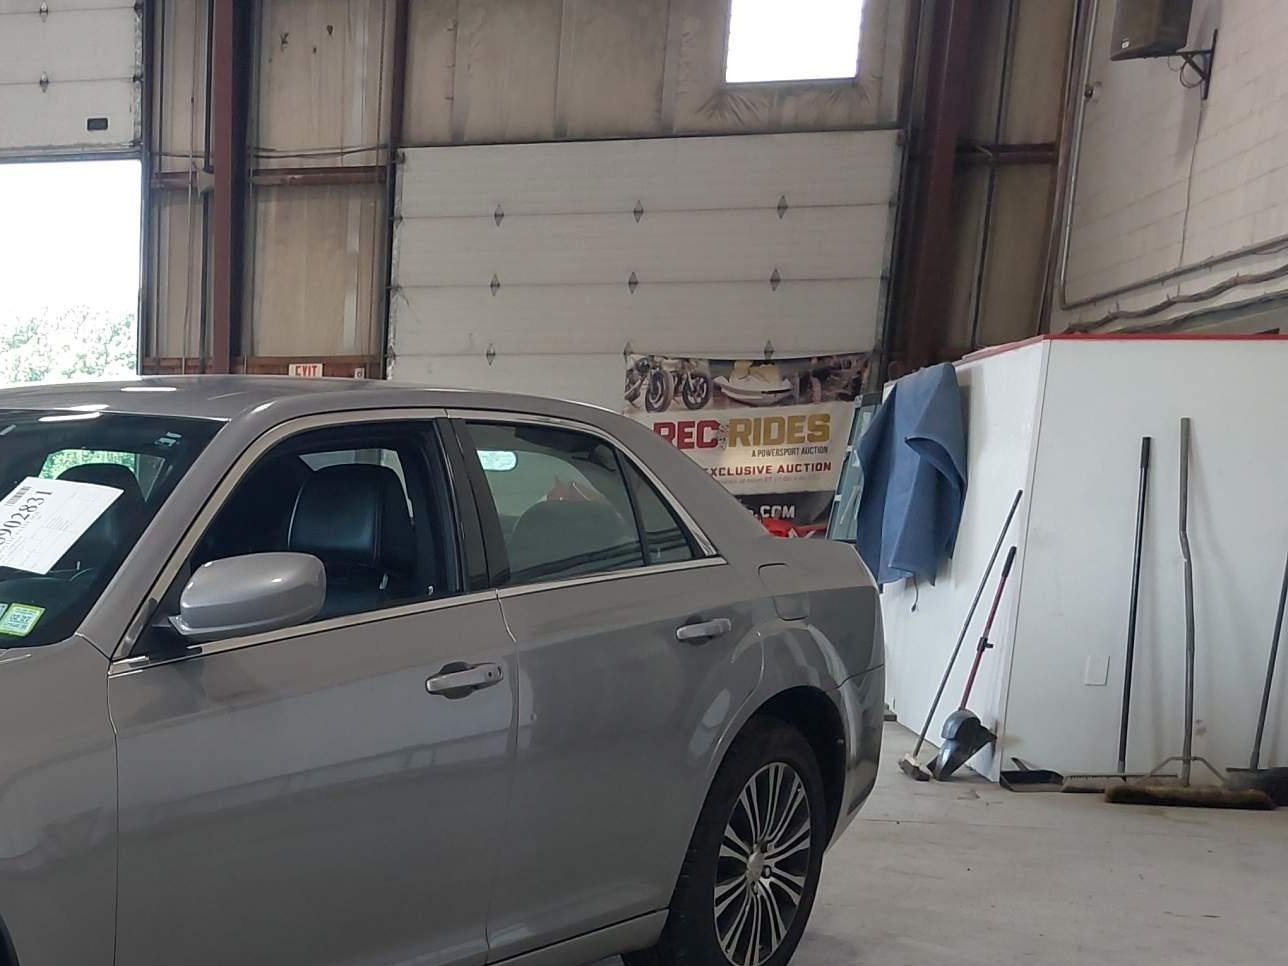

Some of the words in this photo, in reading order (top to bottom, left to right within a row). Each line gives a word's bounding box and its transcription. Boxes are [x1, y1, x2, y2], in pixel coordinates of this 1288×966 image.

[296, 365, 317, 377] EXIT
[654, 420, 720, 449] REC
[728, 413, 830, 448] RIDES
[751, 449, 757, 458] A
[757, 447, 799, 457] POWERSPORT
[801, 445, 828, 455] AUCTION
[776, 462, 832, 474] AUCTION
